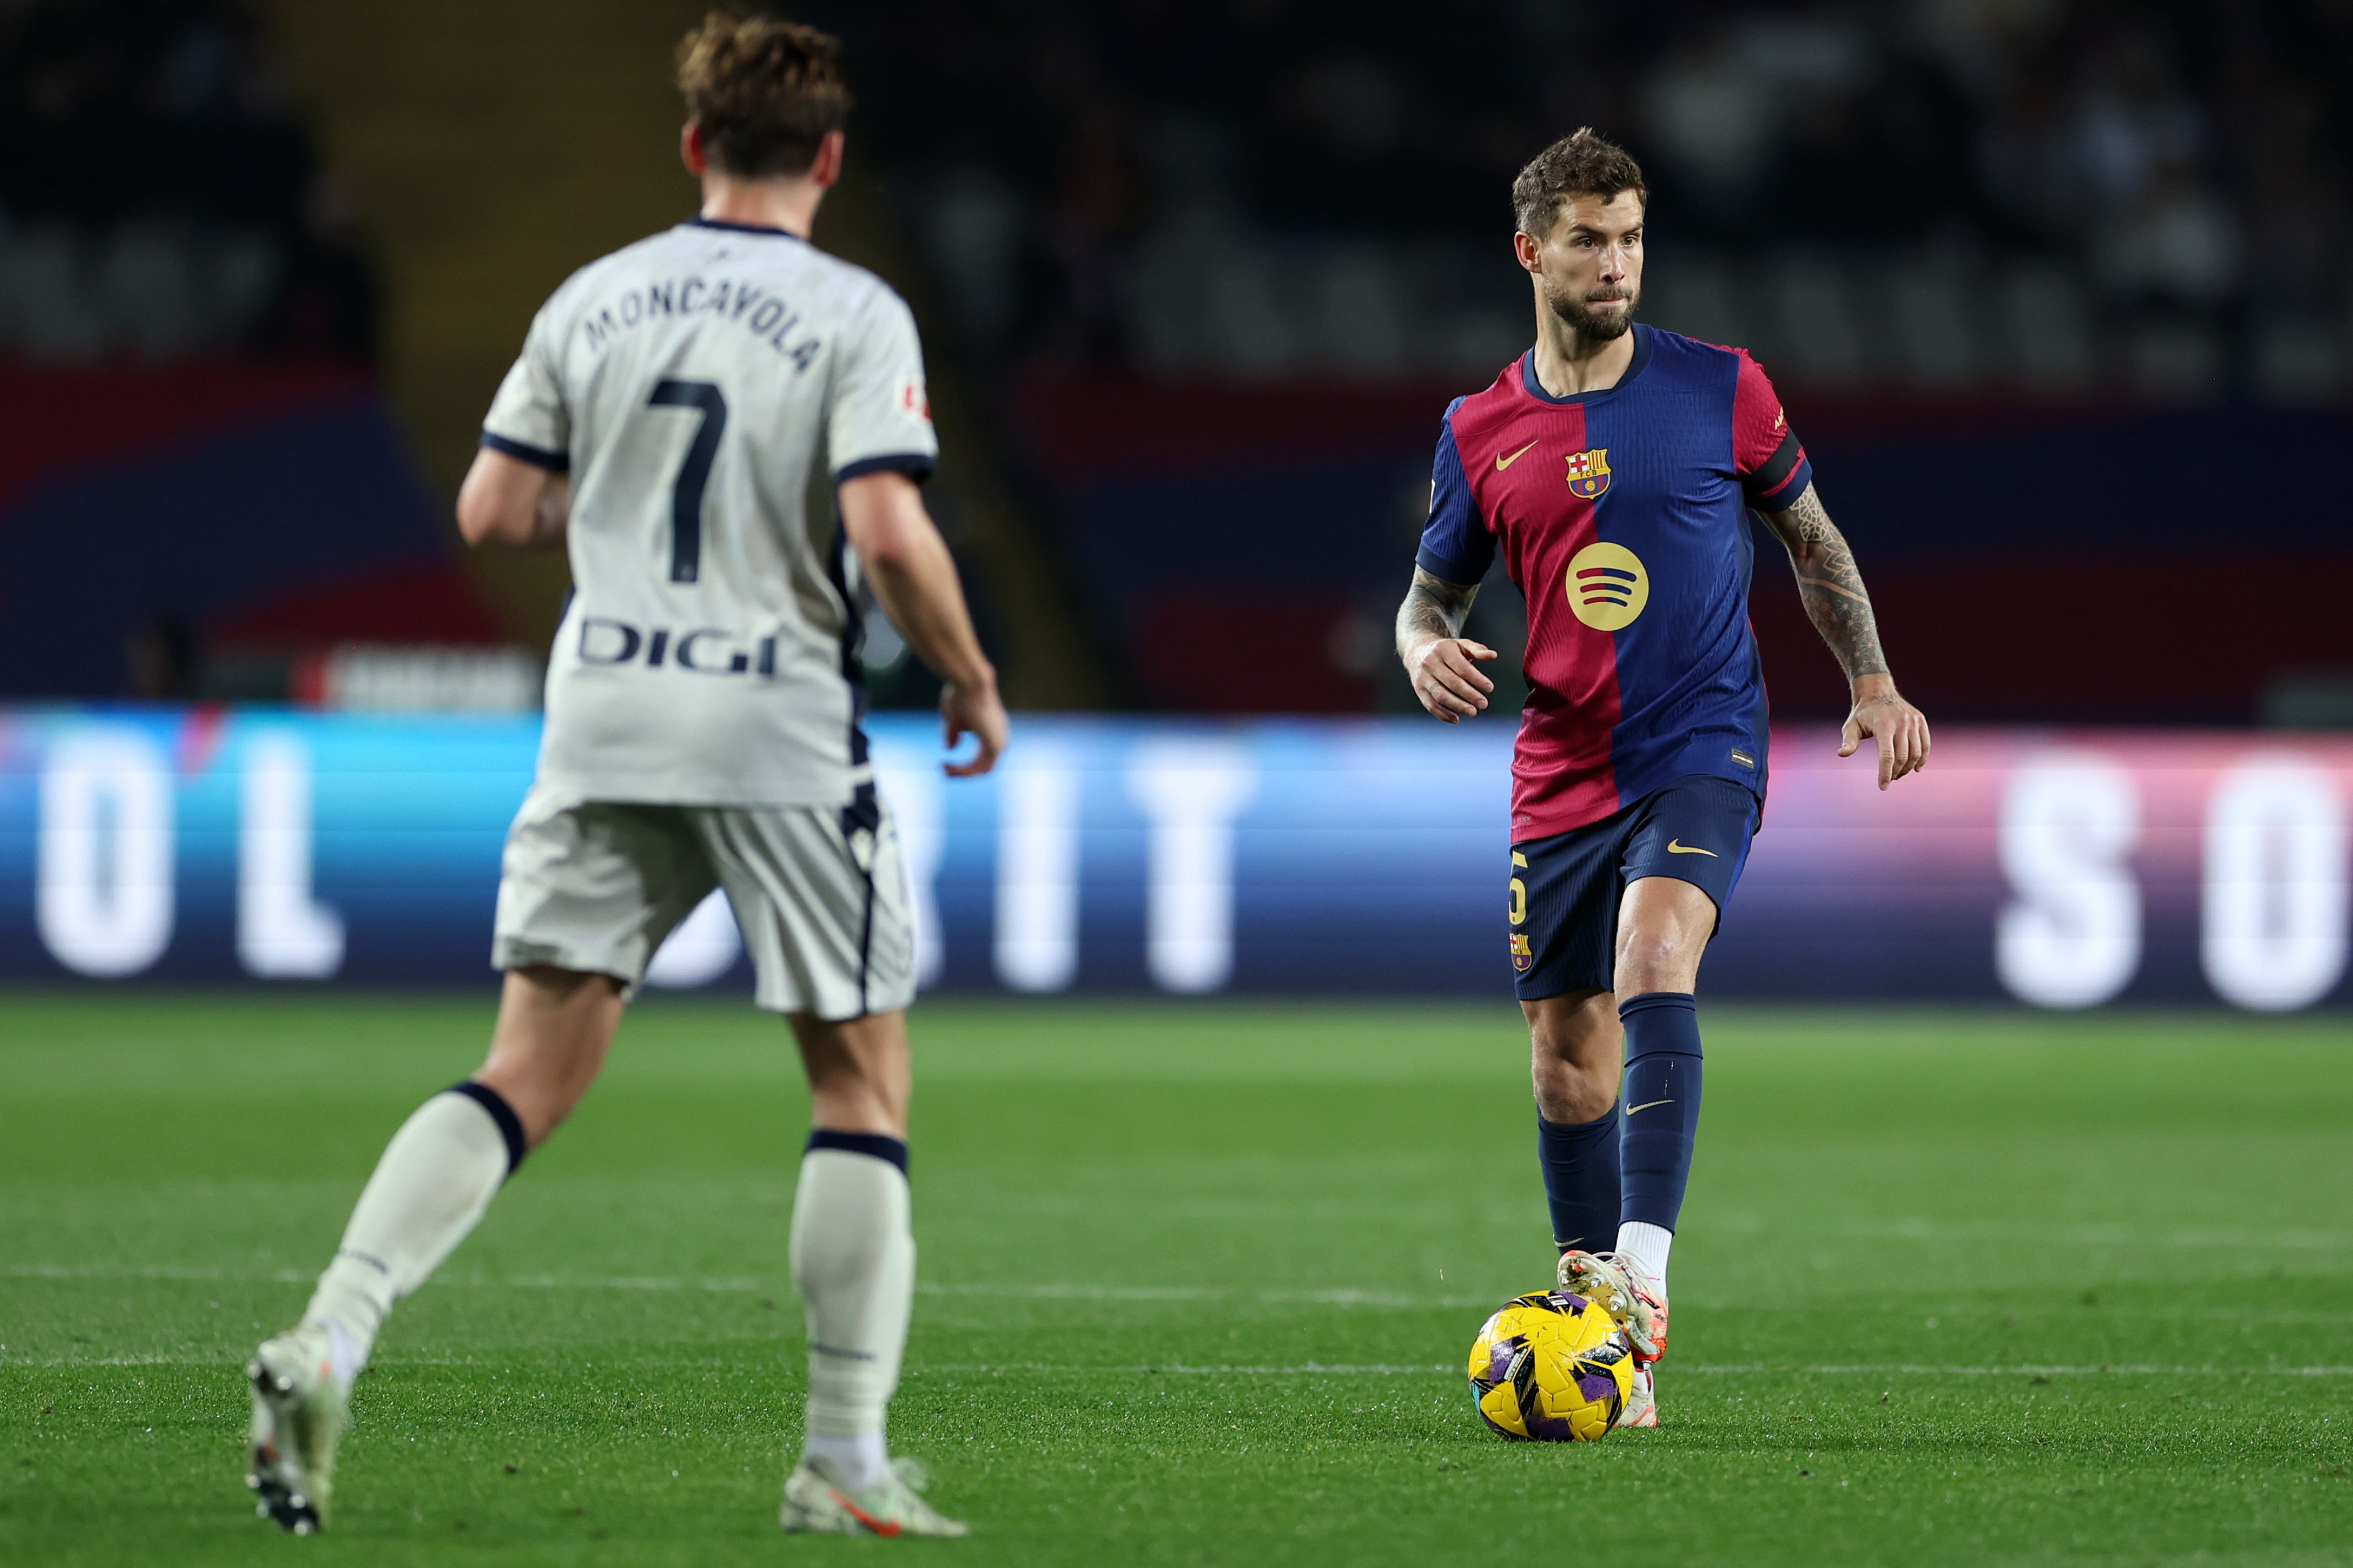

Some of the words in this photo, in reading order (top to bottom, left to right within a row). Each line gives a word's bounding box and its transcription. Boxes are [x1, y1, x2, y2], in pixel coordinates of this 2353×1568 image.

[585, 276, 821, 375] MONCAYOLA
[647, 381, 727, 583] 7
[1580, 470, 1597, 478] FCB
[579, 617, 777, 676] DIGI
[1509, 850, 1528, 925] 5
